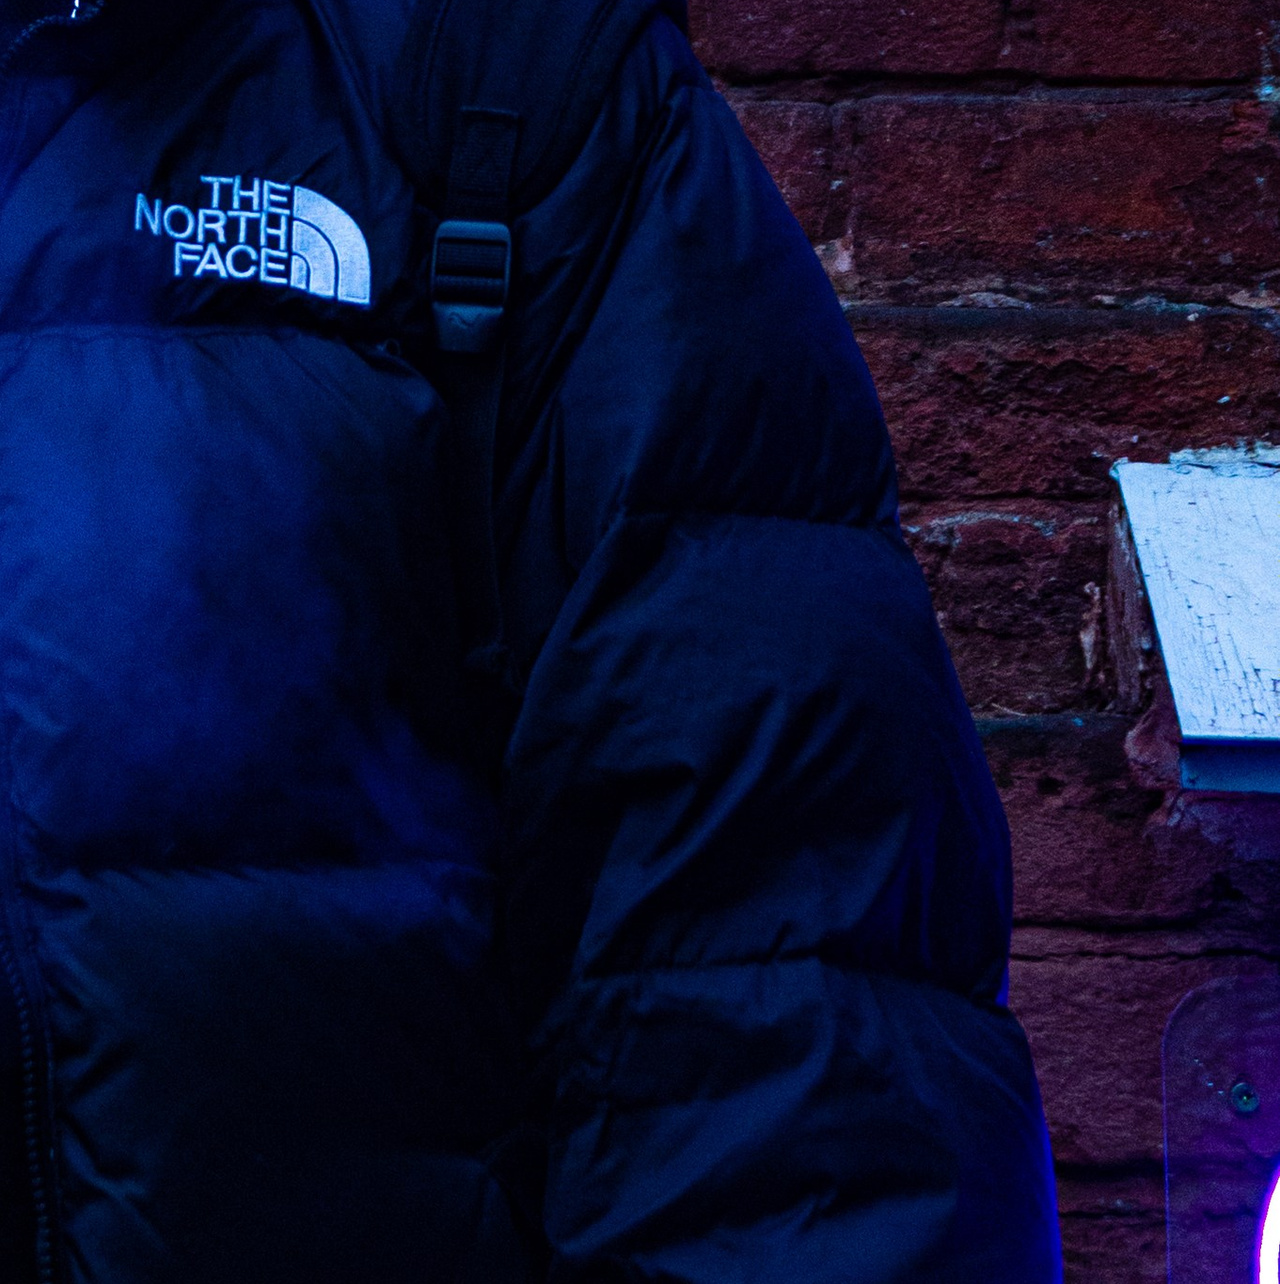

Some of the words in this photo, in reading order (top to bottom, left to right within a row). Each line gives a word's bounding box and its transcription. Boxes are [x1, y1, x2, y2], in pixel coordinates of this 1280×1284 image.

[200, 175, 291, 216] THE
[134, 193, 288, 251] NORTH
[174, 241, 289, 284] FACE
